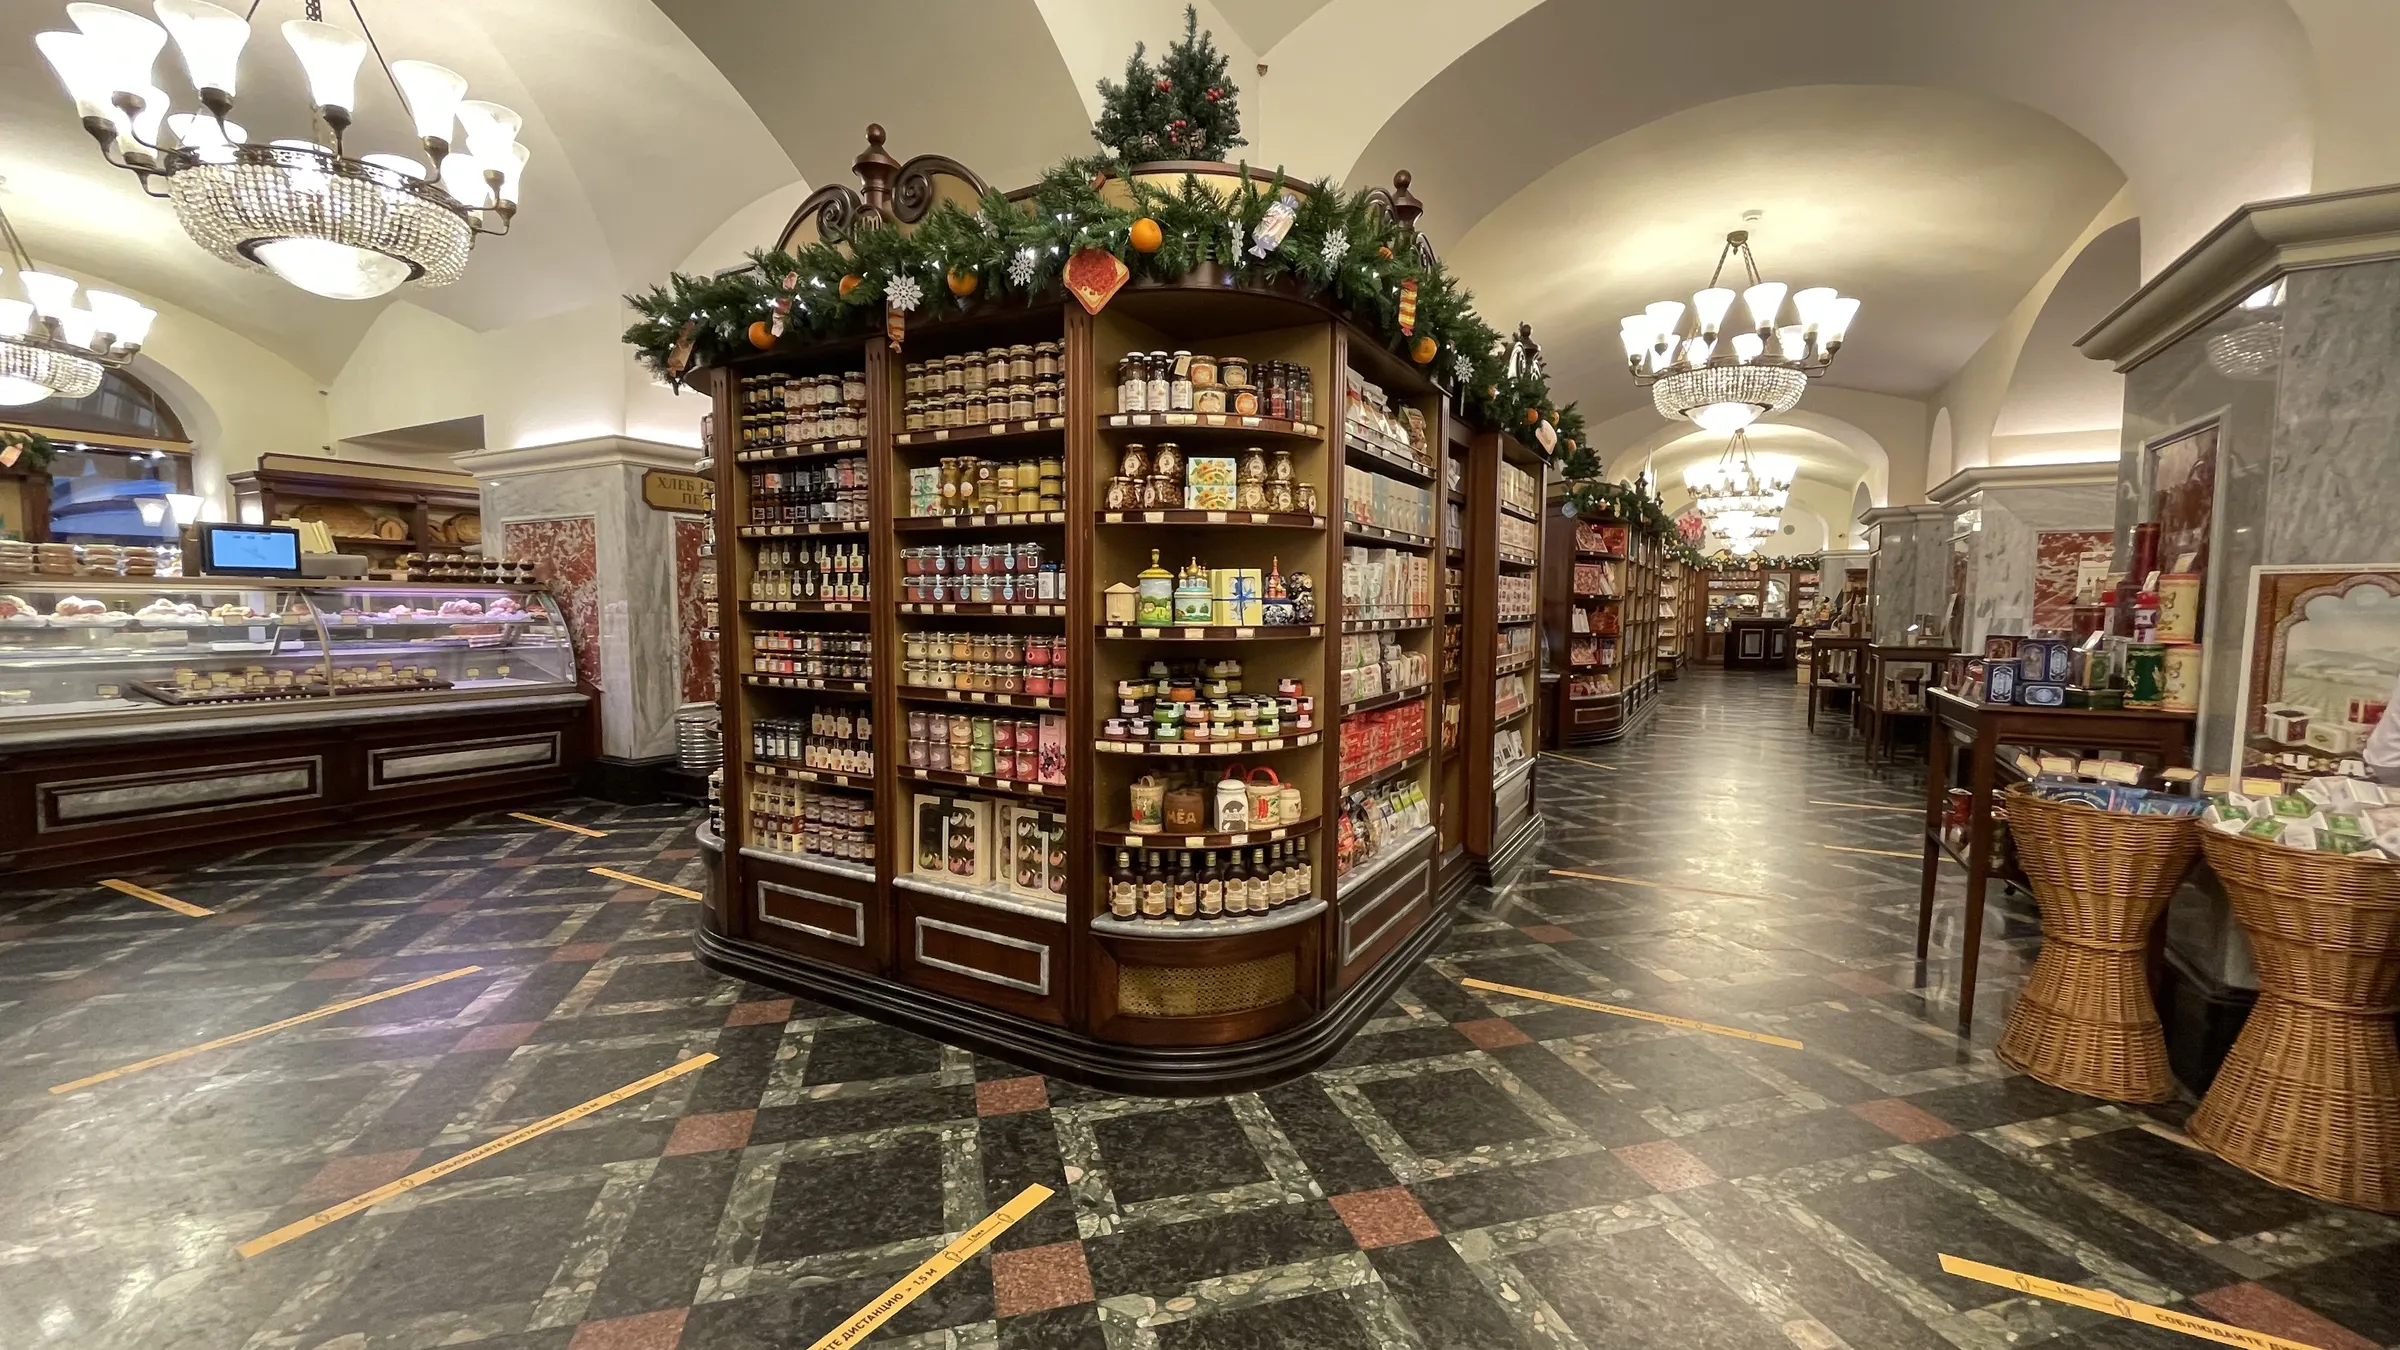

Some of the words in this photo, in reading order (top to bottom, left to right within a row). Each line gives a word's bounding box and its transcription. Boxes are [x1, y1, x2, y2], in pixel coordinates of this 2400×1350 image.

[656, 476, 695, 491] ХЛЕБ
[843, 1292, 904, 1342] ДИСТАНЦИЮ
[913, 1275, 928, 1287] 1,5
[927, 1267, 938, 1278] М
[2155, 1312, 2263, 1348] СОБЛЮДАЙТЕ
